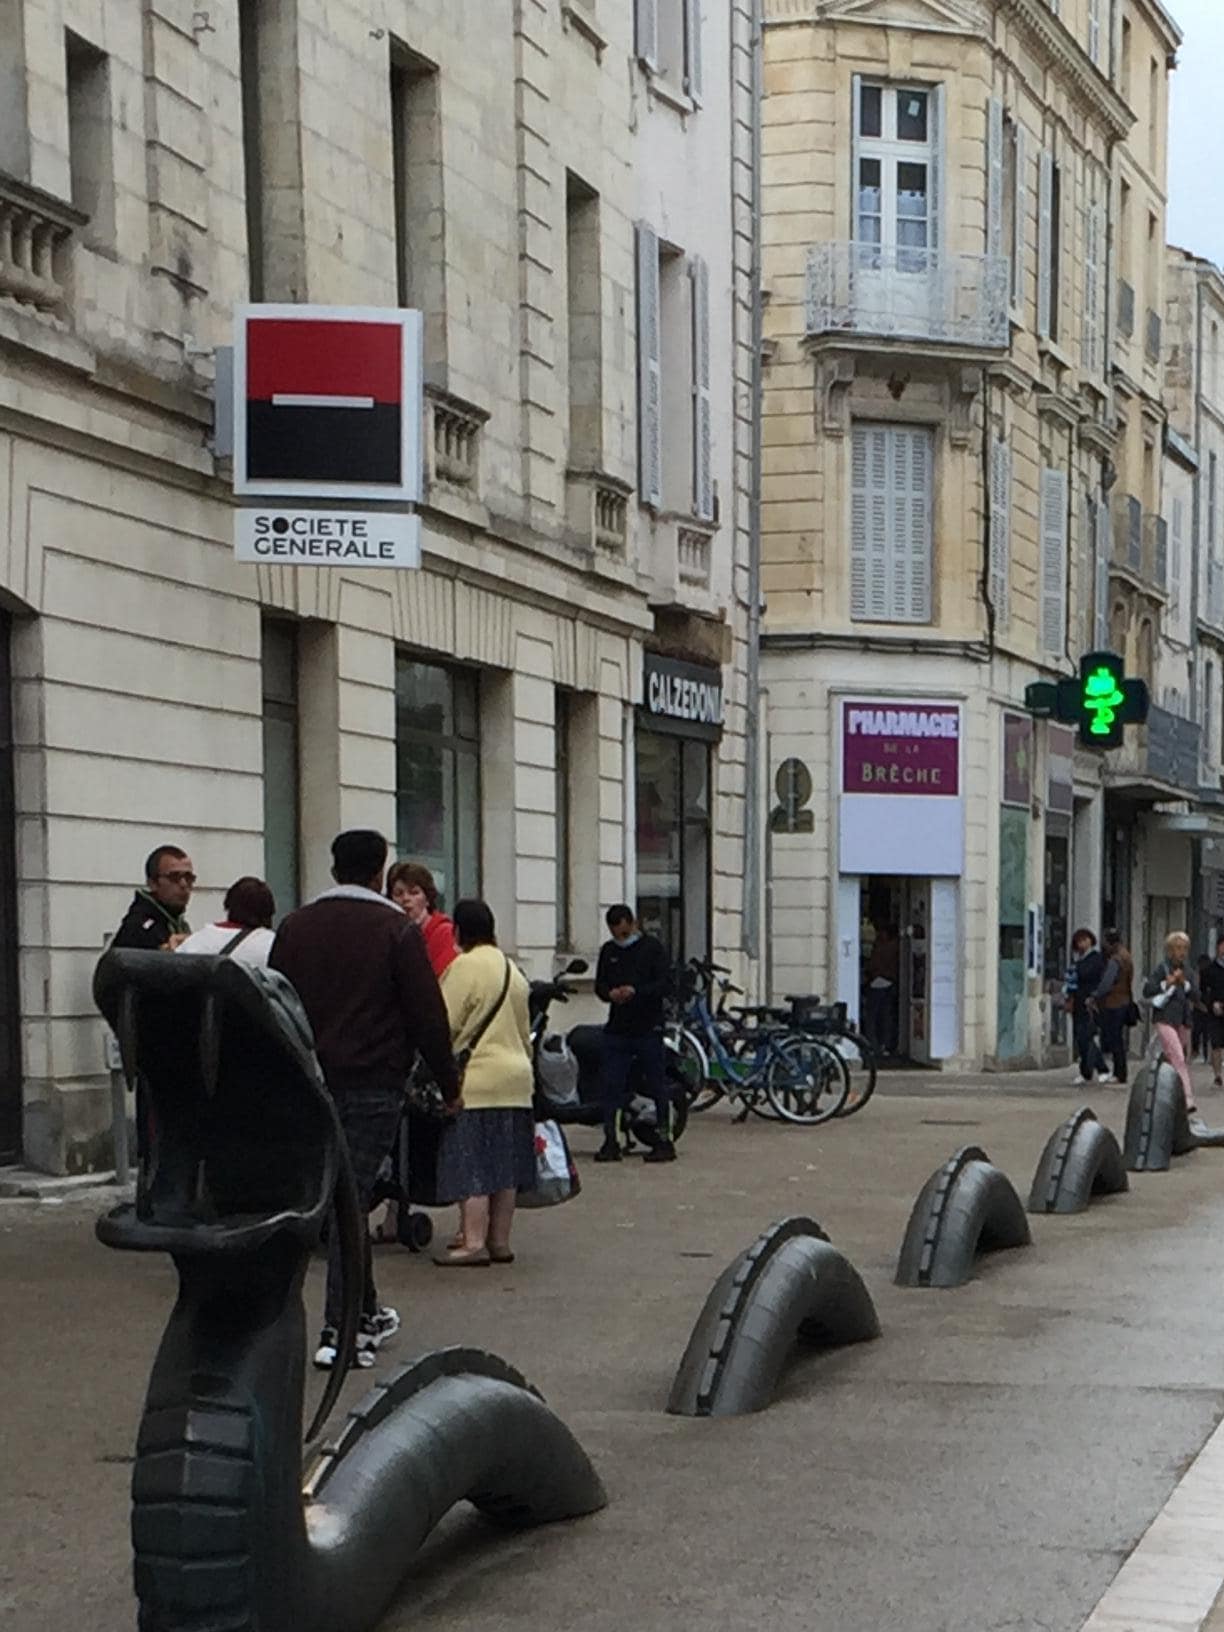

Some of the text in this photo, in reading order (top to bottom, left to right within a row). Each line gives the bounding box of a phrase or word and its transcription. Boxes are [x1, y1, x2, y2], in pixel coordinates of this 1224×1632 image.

[254, 516, 367, 537] SOCIETE
[254, 537, 395, 559] GENERALE
[848, 710, 958, 738] PHARMACIE
